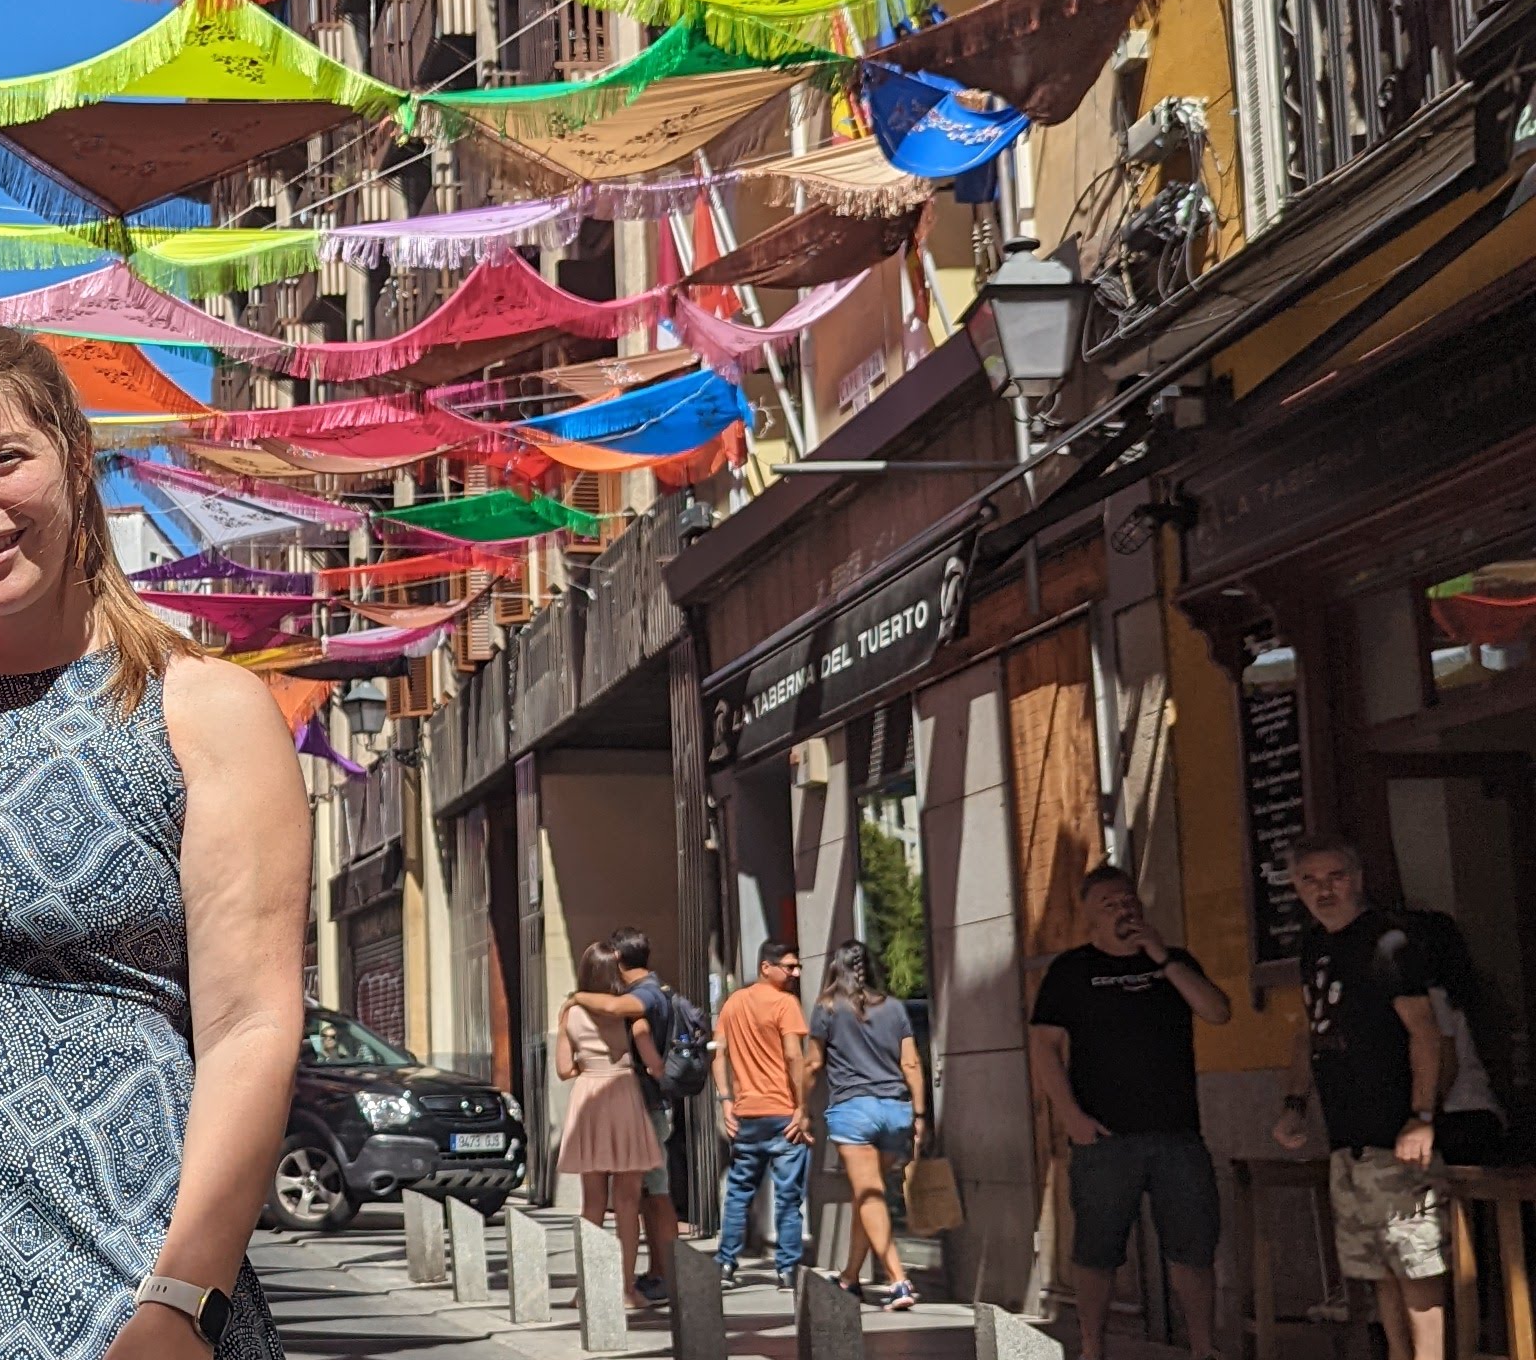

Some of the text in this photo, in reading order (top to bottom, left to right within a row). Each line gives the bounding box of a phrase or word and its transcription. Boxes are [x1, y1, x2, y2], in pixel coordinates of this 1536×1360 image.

[732, 599, 929, 731] LA TABERNA DEL TUERTO
